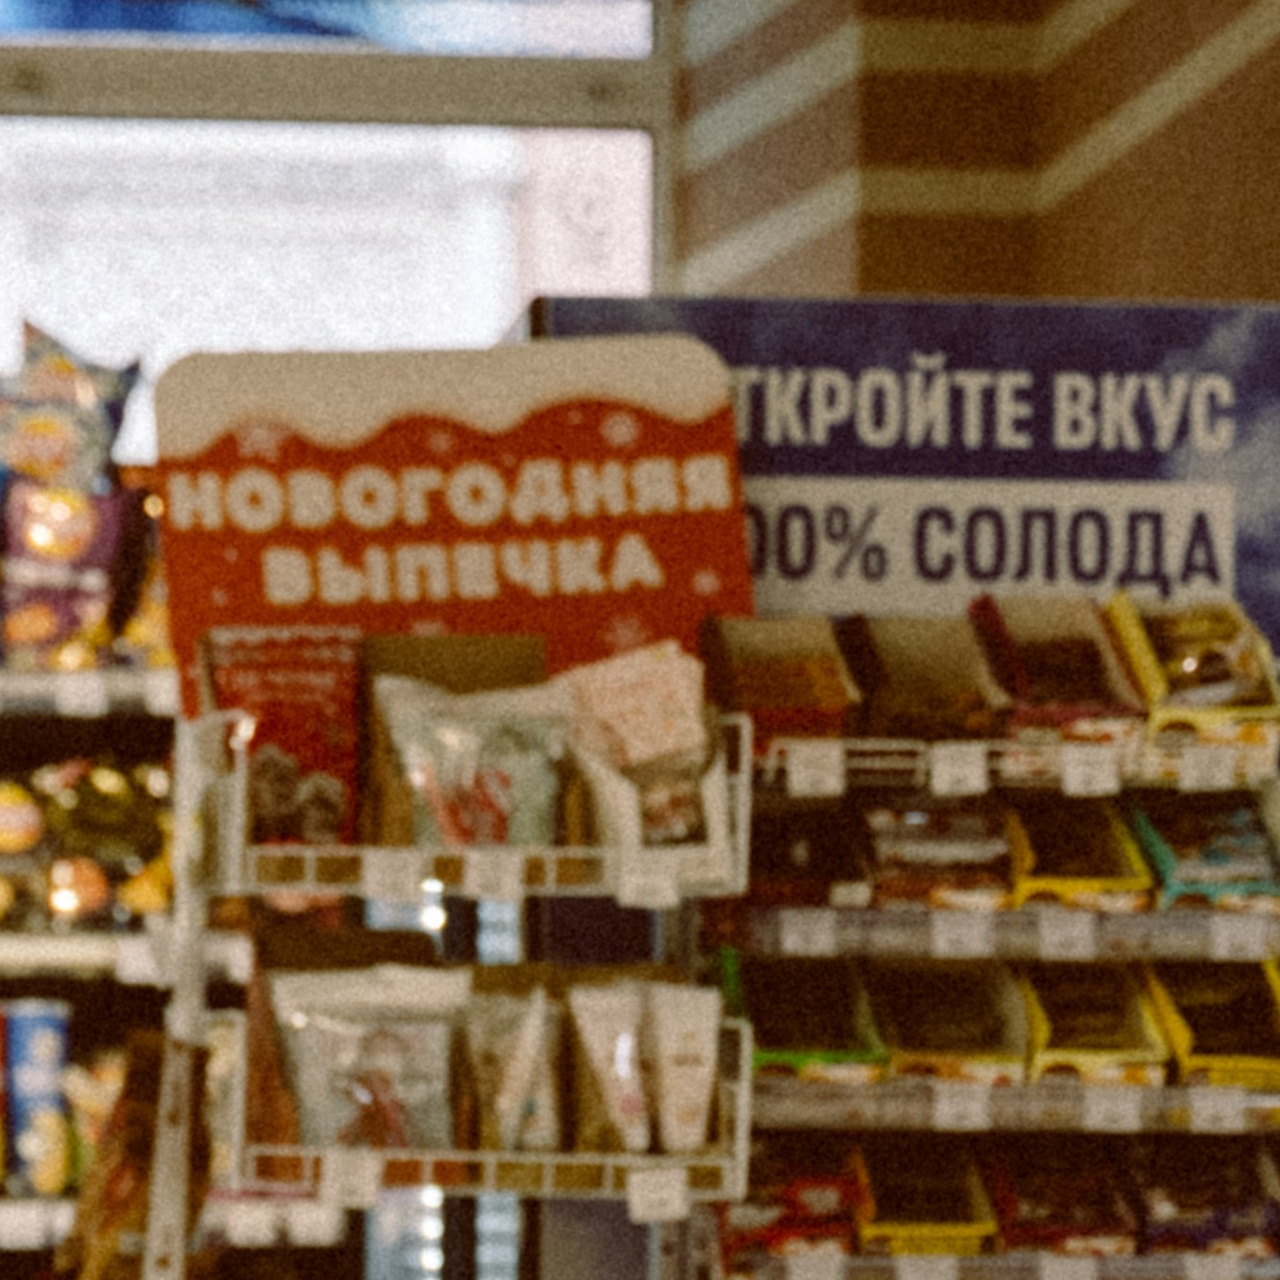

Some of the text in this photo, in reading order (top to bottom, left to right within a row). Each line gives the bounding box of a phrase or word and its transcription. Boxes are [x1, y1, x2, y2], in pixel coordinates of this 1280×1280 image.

[1052, 370, 1236, 454] ВКУС
[167, 452, 733, 534] НОВОГОДНЯЯ
[261, 532, 665, 607] ВЫПЕЧКА
[913, 506, 1221, 597] СОЛОДА
